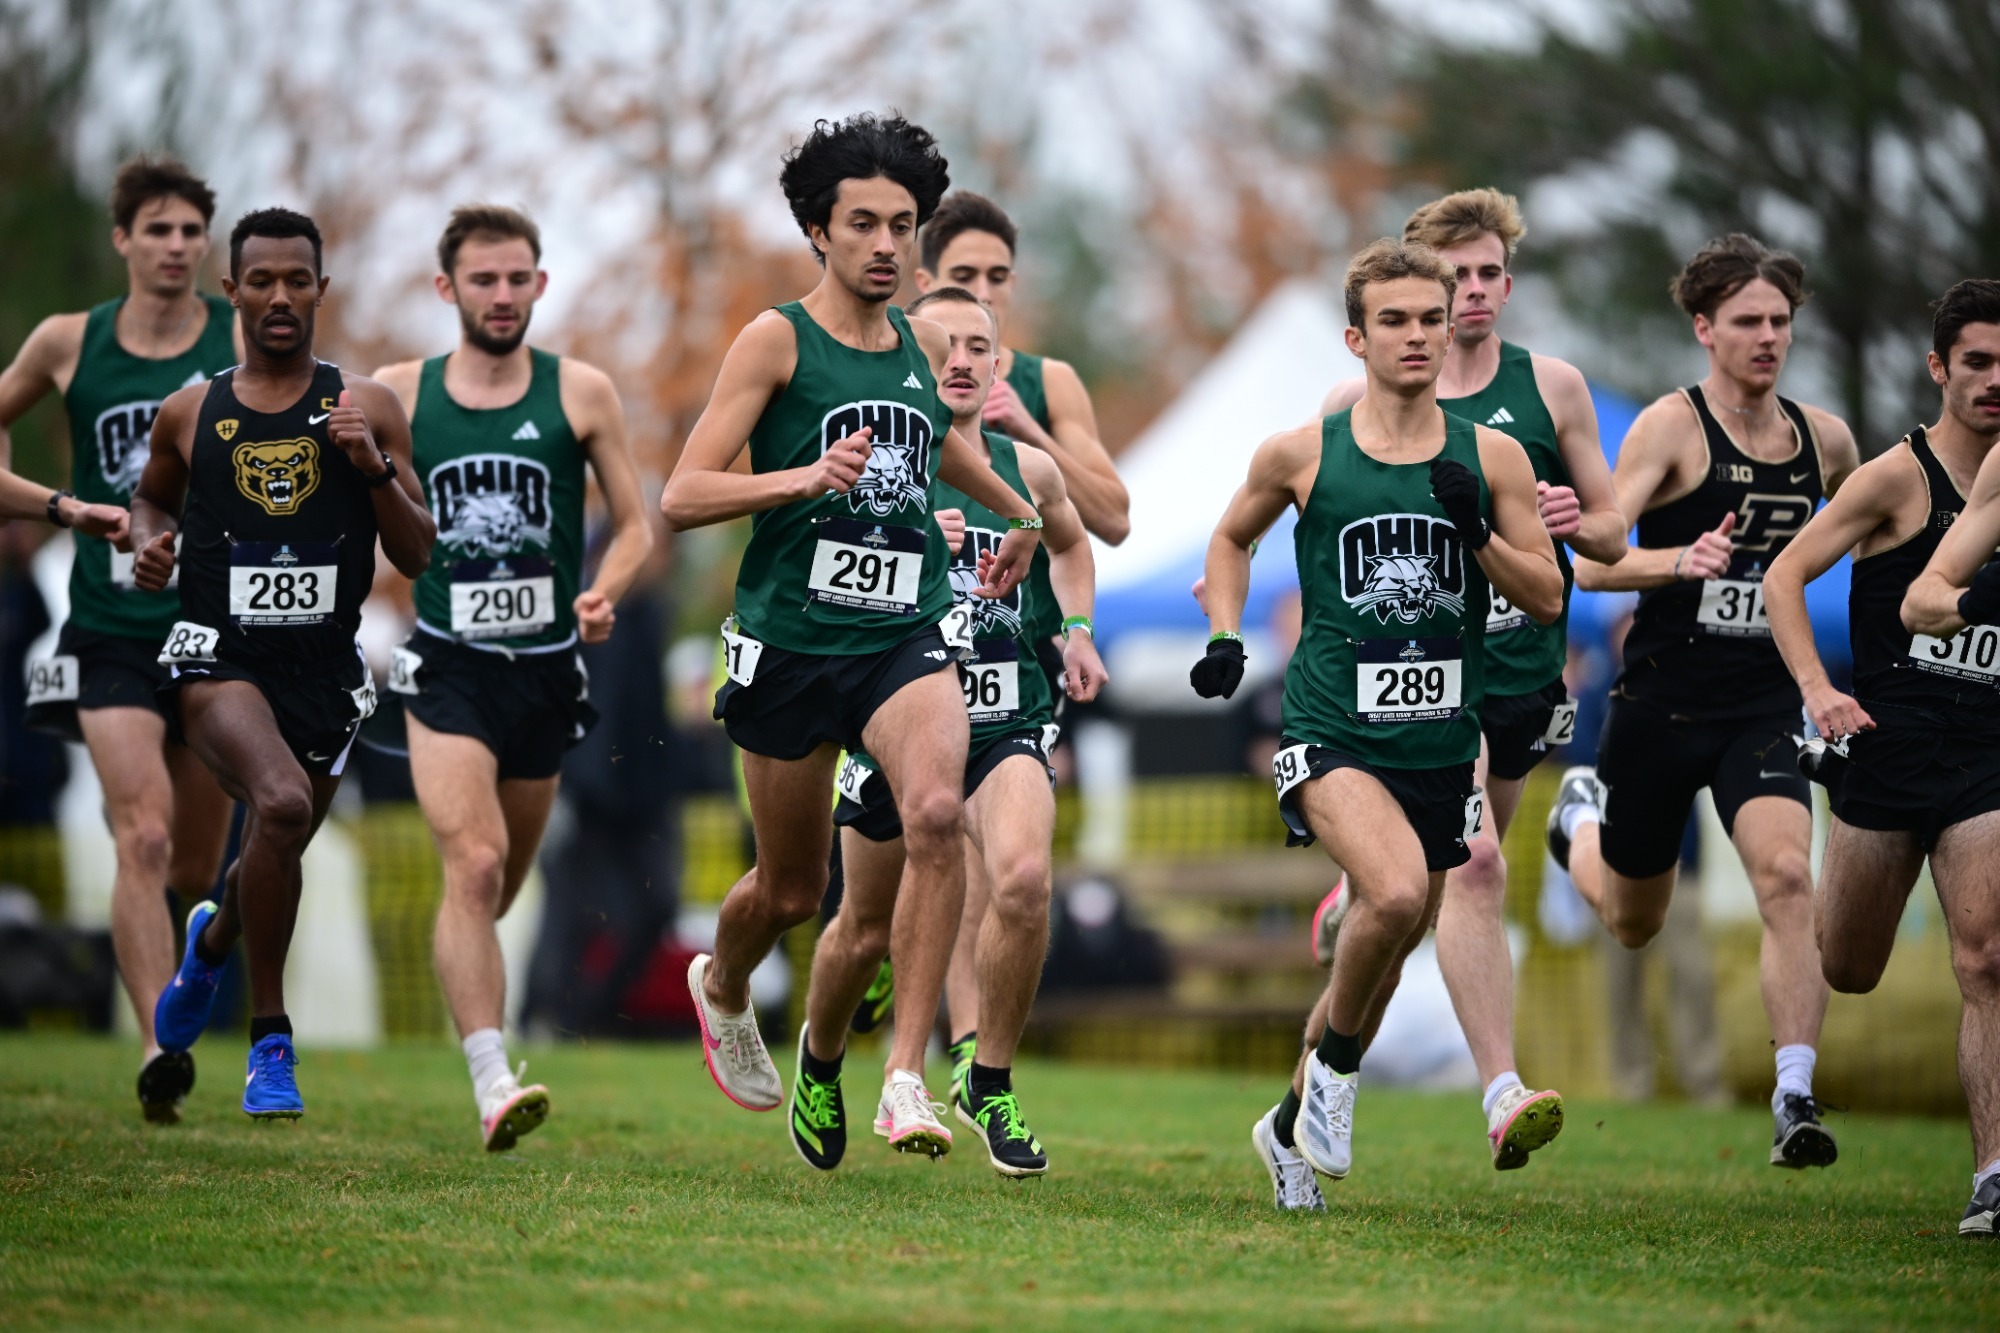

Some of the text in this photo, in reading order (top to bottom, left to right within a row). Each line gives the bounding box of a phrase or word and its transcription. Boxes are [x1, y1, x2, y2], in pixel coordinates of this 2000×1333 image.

[1716, 463, 1754, 483] B1G
[428, 453, 553, 541] OHIO
[1732, 493, 1812, 551] P
[829, 549, 899, 595] 291
[1339, 512, 1465, 603] OHIO
[248, 572, 318, 610] 283
[470, 586, 535, 623] 290
[1716, 587, 1768, 622] 31
[1376, 666, 1444, 706] 289
